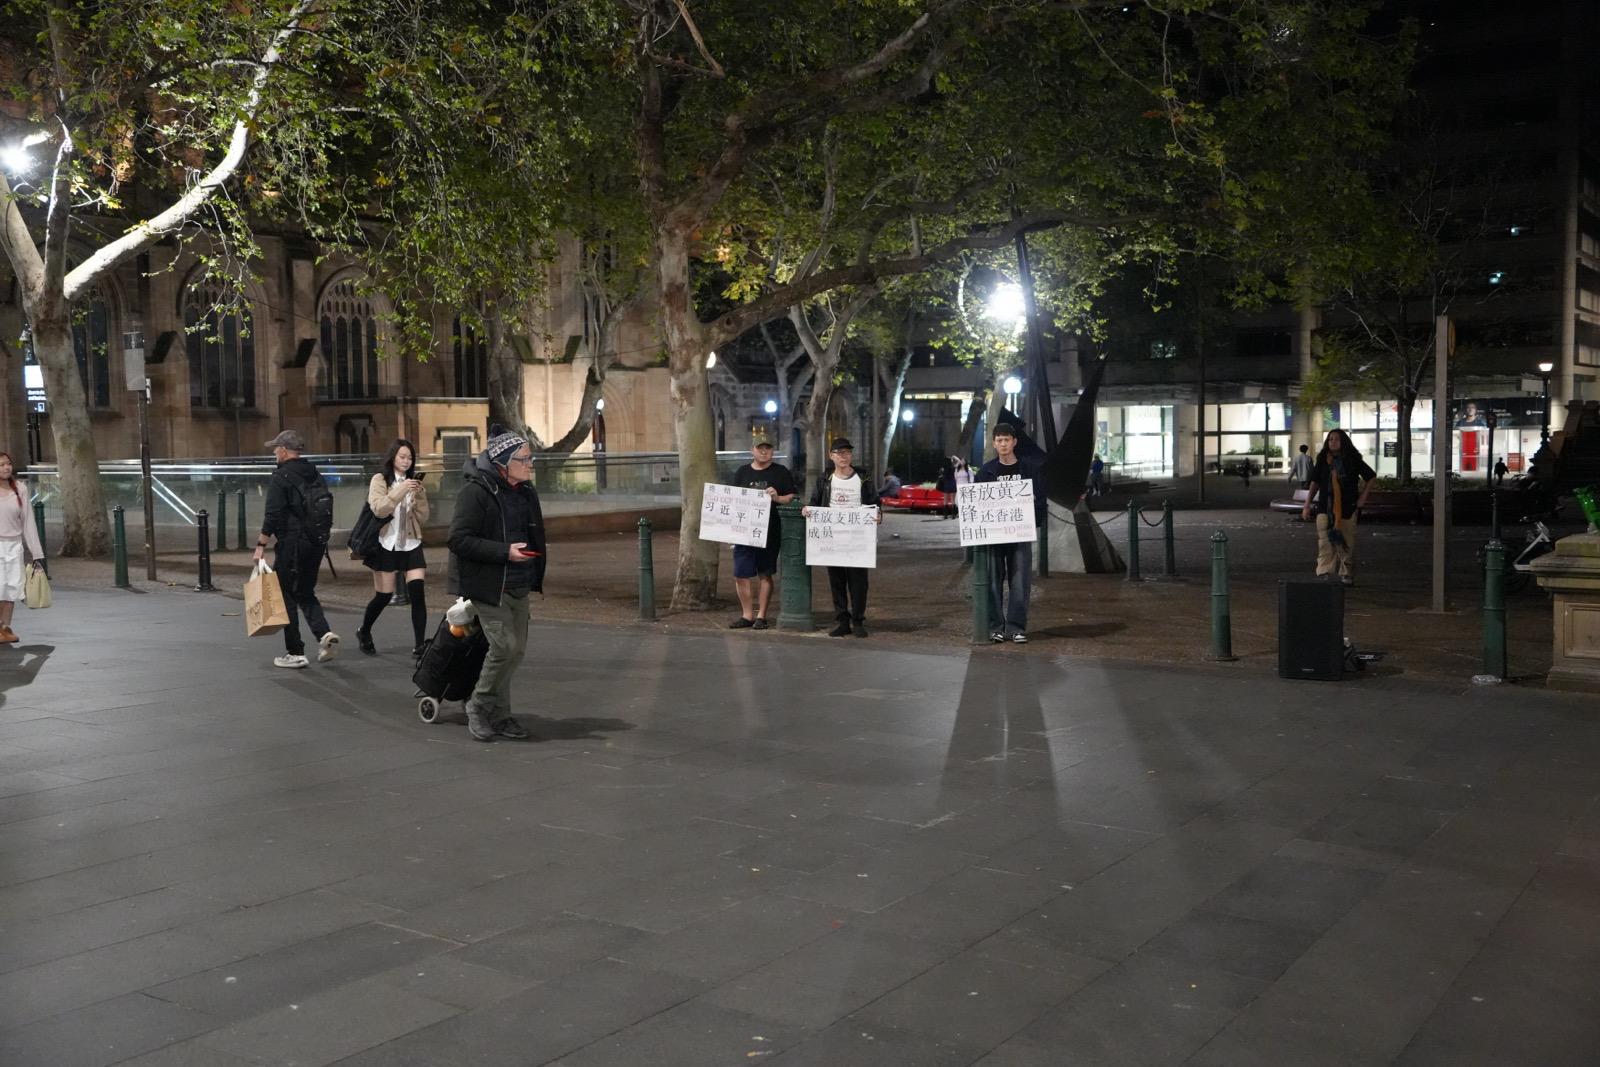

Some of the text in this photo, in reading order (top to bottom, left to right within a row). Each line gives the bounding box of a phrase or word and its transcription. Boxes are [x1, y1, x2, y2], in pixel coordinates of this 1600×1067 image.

[960, 481, 1031, 503] 释放黄之
[808, 526, 833, 539] 成员
[962, 525, 987, 541] 自由
